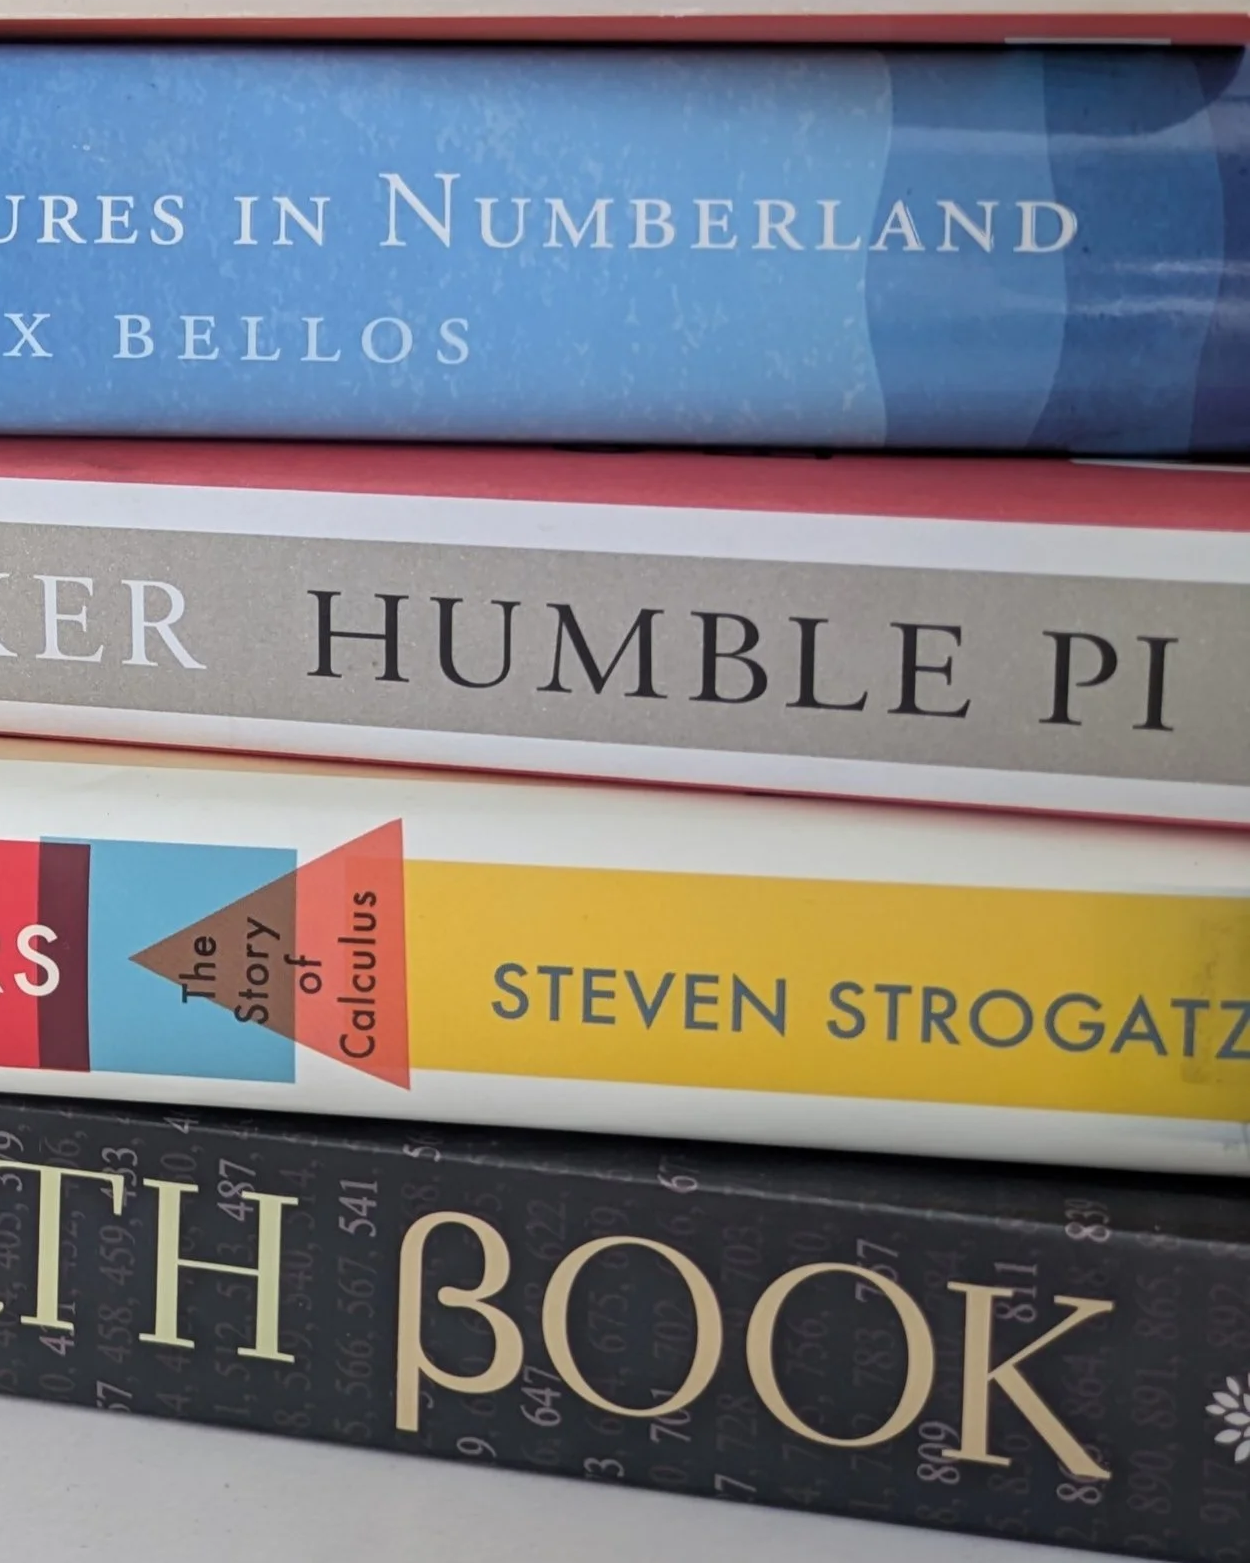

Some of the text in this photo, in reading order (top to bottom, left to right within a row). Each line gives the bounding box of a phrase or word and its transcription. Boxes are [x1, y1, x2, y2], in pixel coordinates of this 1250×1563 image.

[112, 314, 470, 365] BELLOS
[306, 589, 971, 719] HUMBLE
[1038, 630, 1179, 732] PI
[178, 935, 217, 1003] The
[234, 917, 281, 1025] Story
[283, 954, 323, 994] of
[337, 890, 377, 1059] Calculus
[491, 962, 1250, 1060] STEVEN STROGATZ
